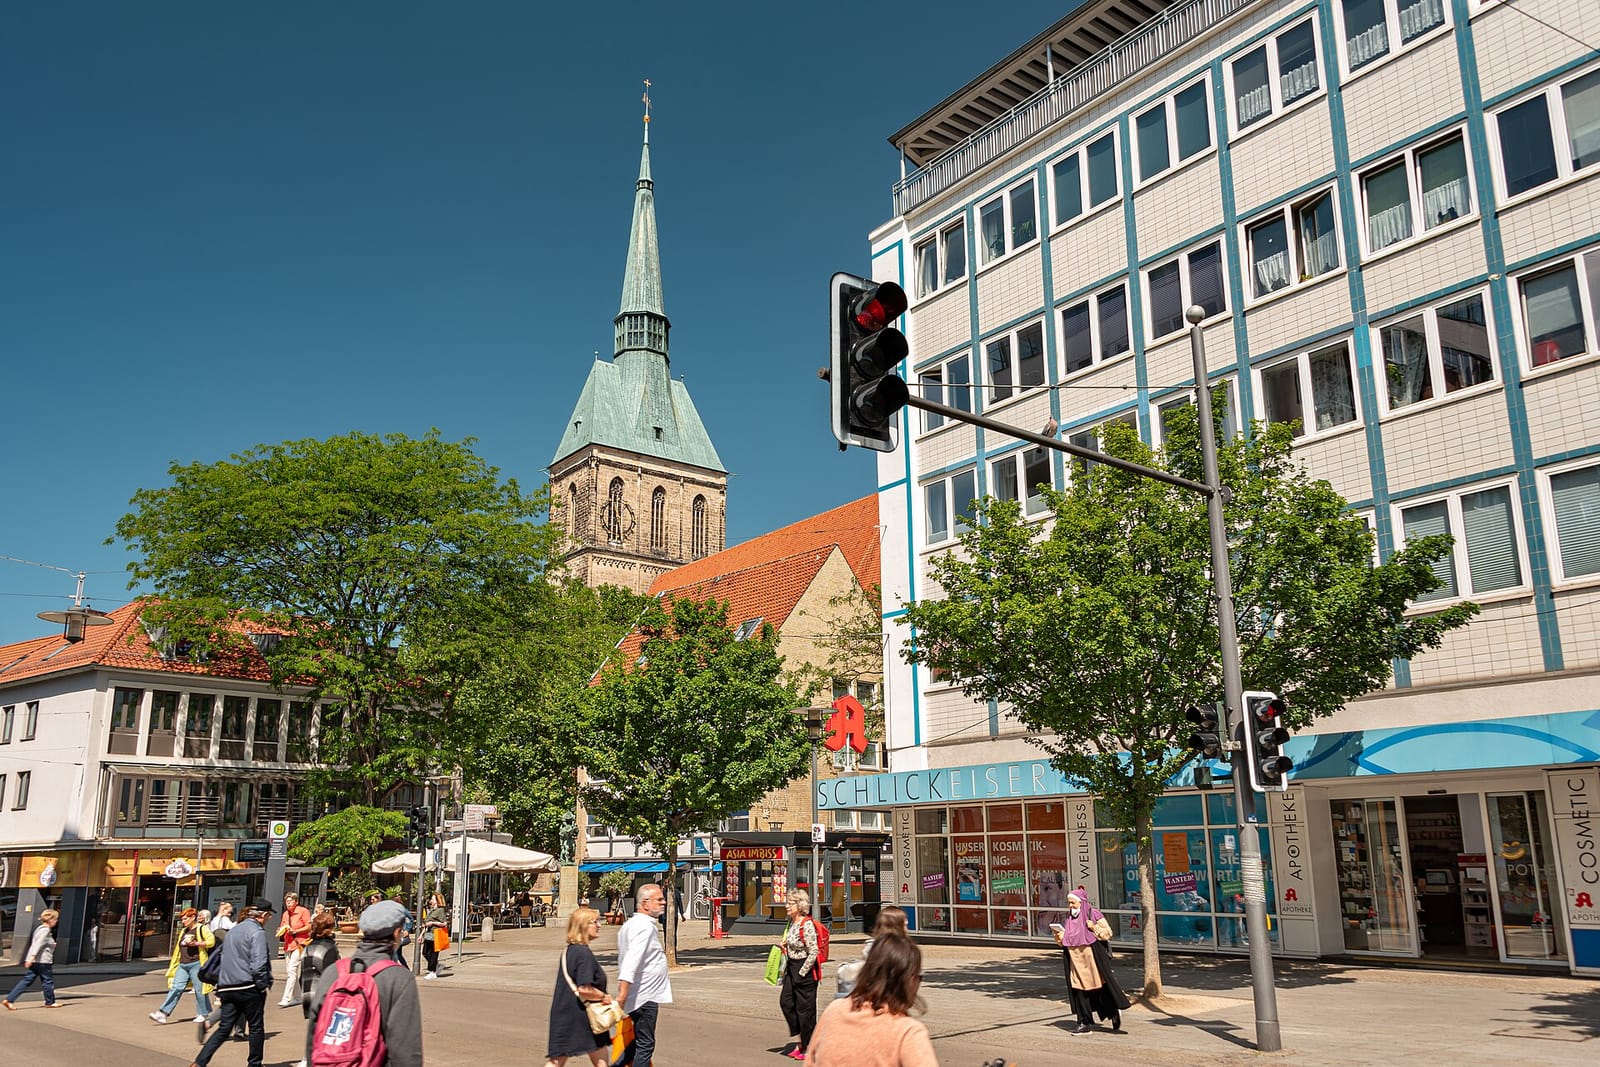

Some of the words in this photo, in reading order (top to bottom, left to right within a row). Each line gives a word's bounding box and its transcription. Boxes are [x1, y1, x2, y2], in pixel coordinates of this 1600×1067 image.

[818, 763, 1048, 808] SCHLICKEISER
[726, 850, 746, 860] ASIA
[748, 848, 777, 860] IMBISS
[902, 812, 912, 879] COSMETIC
[1076, 803, 1091, 880] WELLNESS
[1282, 792, 1303, 881] APOTHEKE
[1567, 778, 1600, 885] COSMETIC
[1164, 874, 1195, 885] WANTED!
